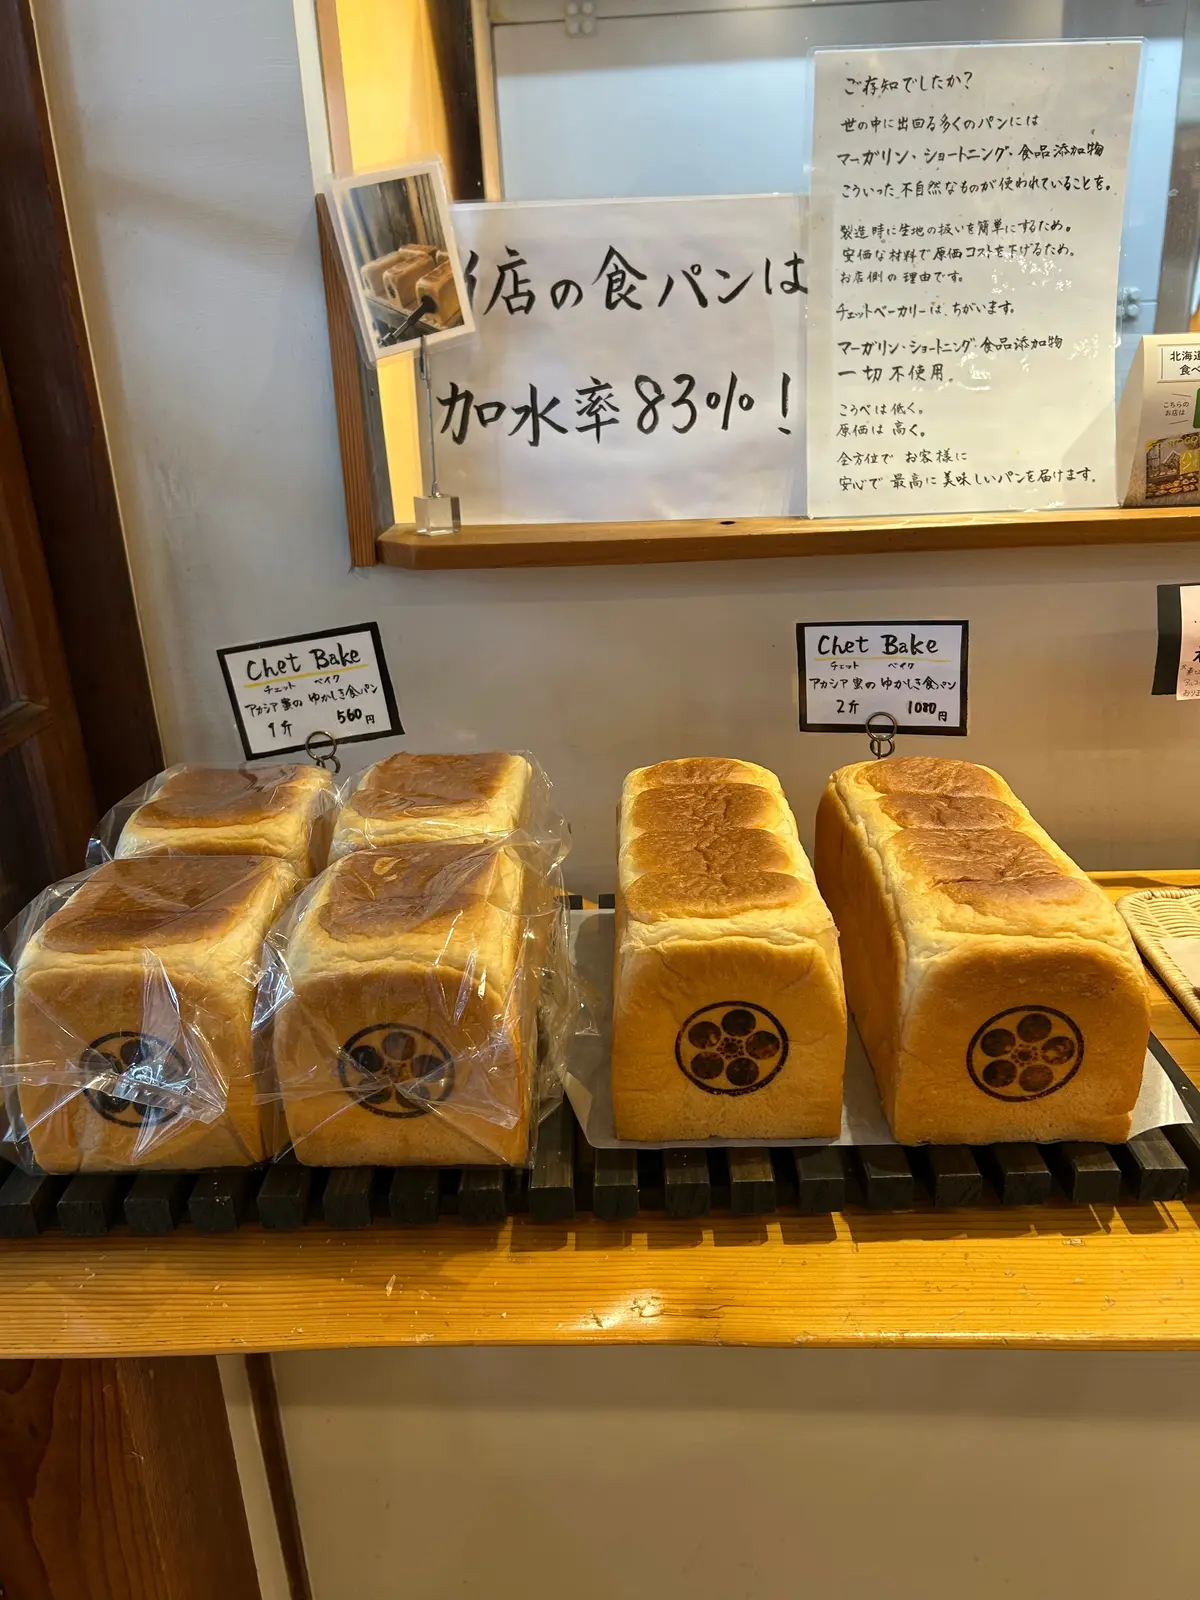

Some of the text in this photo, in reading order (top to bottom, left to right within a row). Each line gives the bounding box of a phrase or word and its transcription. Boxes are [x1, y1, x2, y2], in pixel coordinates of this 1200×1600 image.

[844, 71, 973, 95] ご存知でしたか?
[840, 113, 1039, 133] 世の中に出回る多くのパンには
[839, 218, 1072, 240] 製造時に生地の扱いを簡単にするため。
[842, 243, 1075, 264] 安価な材料で原価コストを下げるため。
[840, 270, 964, 285] お店側の理由です。
[838, 402, 924, 417] こうべは低く。
[1163, 401, 1190, 409] こちらの
[835, 420, 926, 437] 原価は高く。
[838, 466, 1097, 491] 安心で最高に美味しいパンを届けます。
[817, 632, 939, 656] Chet Bake
[246, 642, 361, 681] Chet Bake
[829, 661, 859, 670] チェット
[263, 681, 296, 695] チェット
[336, 707, 375, 725] 560円
[907, 701, 948, 722] 1080円
